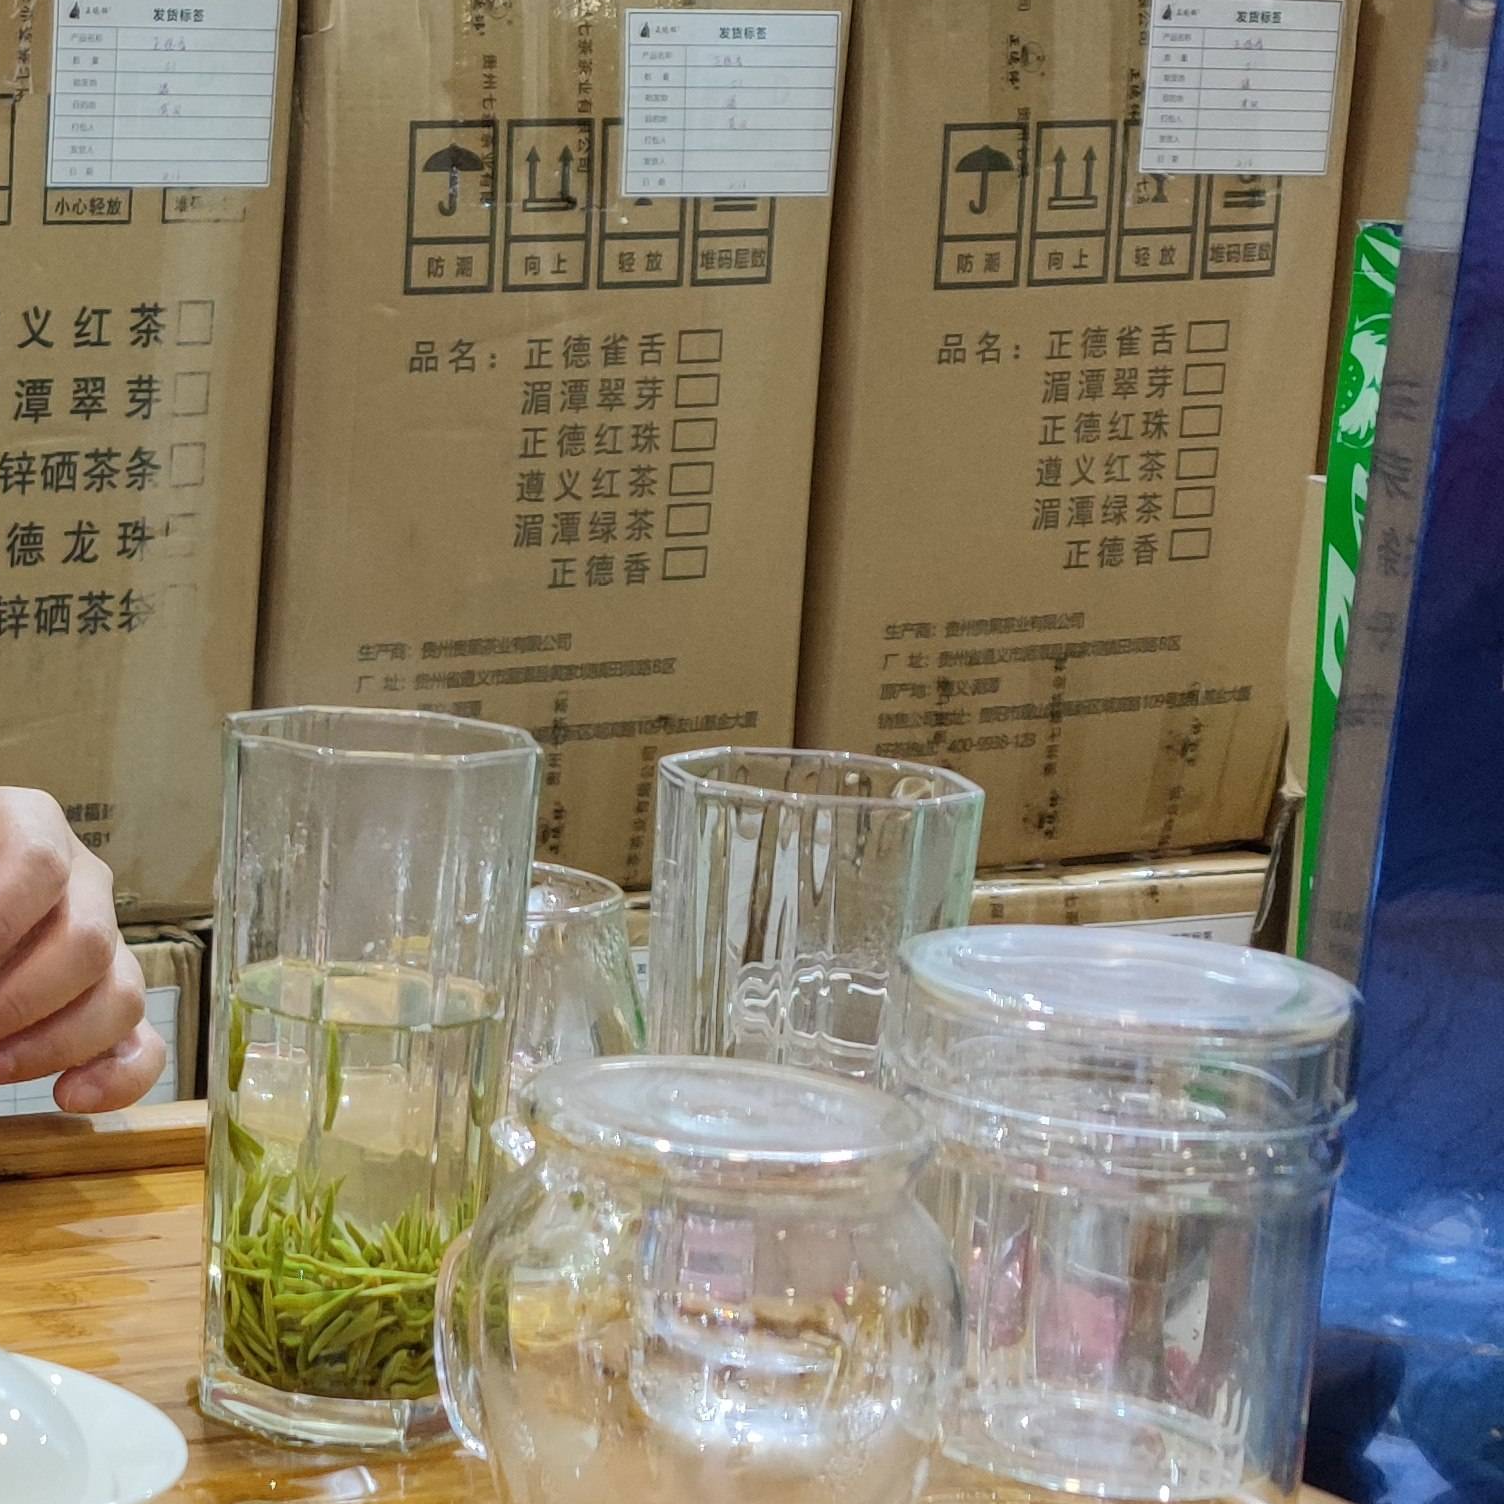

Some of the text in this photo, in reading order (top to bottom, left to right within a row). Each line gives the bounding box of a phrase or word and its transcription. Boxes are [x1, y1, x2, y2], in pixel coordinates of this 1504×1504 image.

[152, 8, 206, 24] 发货标签
[1235, 10, 1283, 25] 发货标签
[719, 26, 769, 41] 发货标签
[54, 198, 123, 216] 小心轻放
[426, 250, 474, 279] 防潮
[523, 250, 570, 277] 向上
[617, 249, 665, 274] 轻放
[698, 244, 770, 274] 堆码层数
[956, 250, 1003, 276] 防潮
[1046, 246, 1089, 271] 向上
[1133, 244, 1178, 269] 轻放
[1209, 239, 1273, 266] 堆码层数
[525, 330, 667, 370] 正德雀舌
[1045, 325, 1180, 362] 正德雀舌
[521, 376, 666, 415] 湄潭翠芽
[1042, 366, 1177, 404] 湄潭翠芽
[518, 421, 662, 461] 正德红珠
[1038, 408, 1172, 447] 正德红珠
[516, 465, 660, 503] 遵义红茶
[1035, 449, 1168, 487] 遵义红茶
[513, 507, 657, 546] 湄潭绿茶
[1032, 492, 1165, 531] 湄潭绿茶
[1063, 533, 1162, 571] 正德香
[547, 549, 652, 589] 正德香
